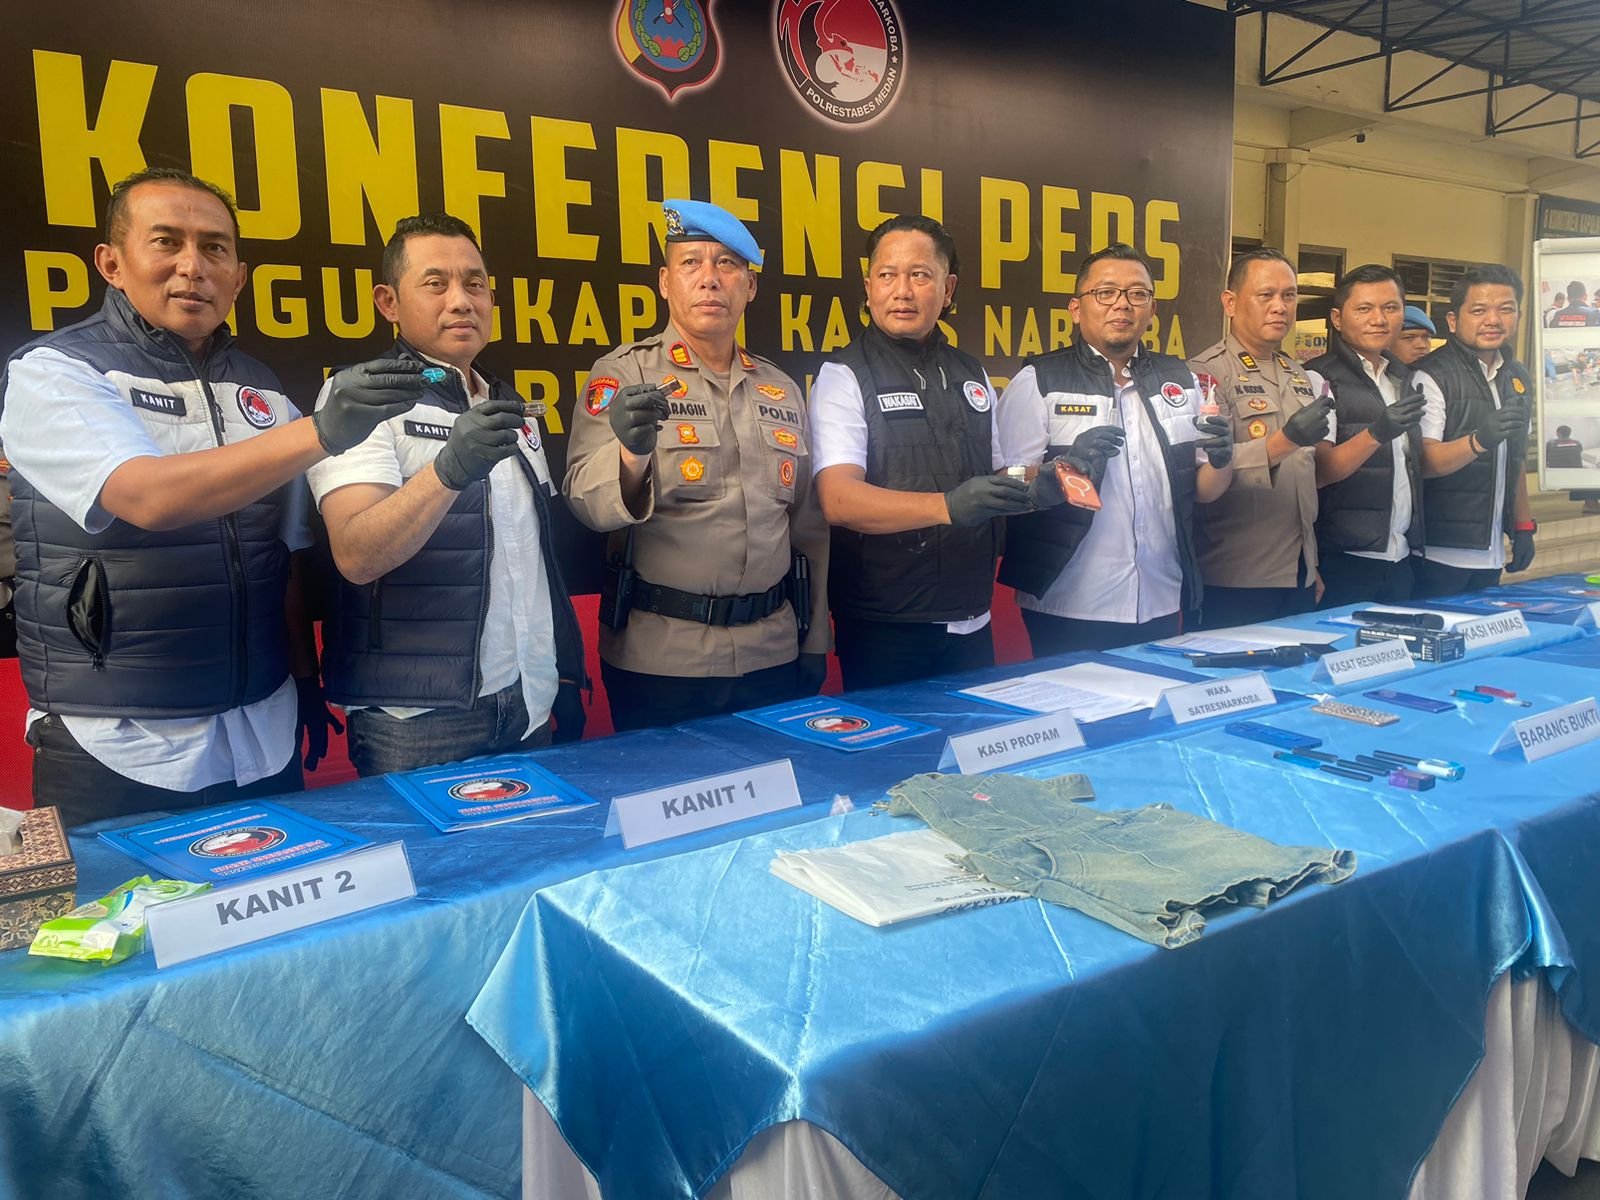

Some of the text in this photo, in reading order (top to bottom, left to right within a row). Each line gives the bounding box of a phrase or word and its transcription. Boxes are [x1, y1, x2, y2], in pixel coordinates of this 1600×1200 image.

[874, 0, 899, 52] ARKOBA
[806, 67, 897, 118] POLRESTABES MEDAN
[140, 394, 175, 409] KANIT
[758, 405, 799, 424] POLRI
[415, 424, 450, 437] KANIT
[1462, 617, 1524, 640] KASI HUMAS
[1329, 658, 1356, 674] KASAT
[1357, 647, 1408, 669] RESNARKOBA
[1205, 685, 1232, 697] WAKA
[1188, 694, 1262, 716] SATRESNARKOBA
[1519, 708, 1600, 748] BARANG BUKTI
[977, 728, 1060, 758] KASI PROPAM
[661, 780, 756, 819] KANIT 1
[215, 870, 356, 926] KANIT 2
